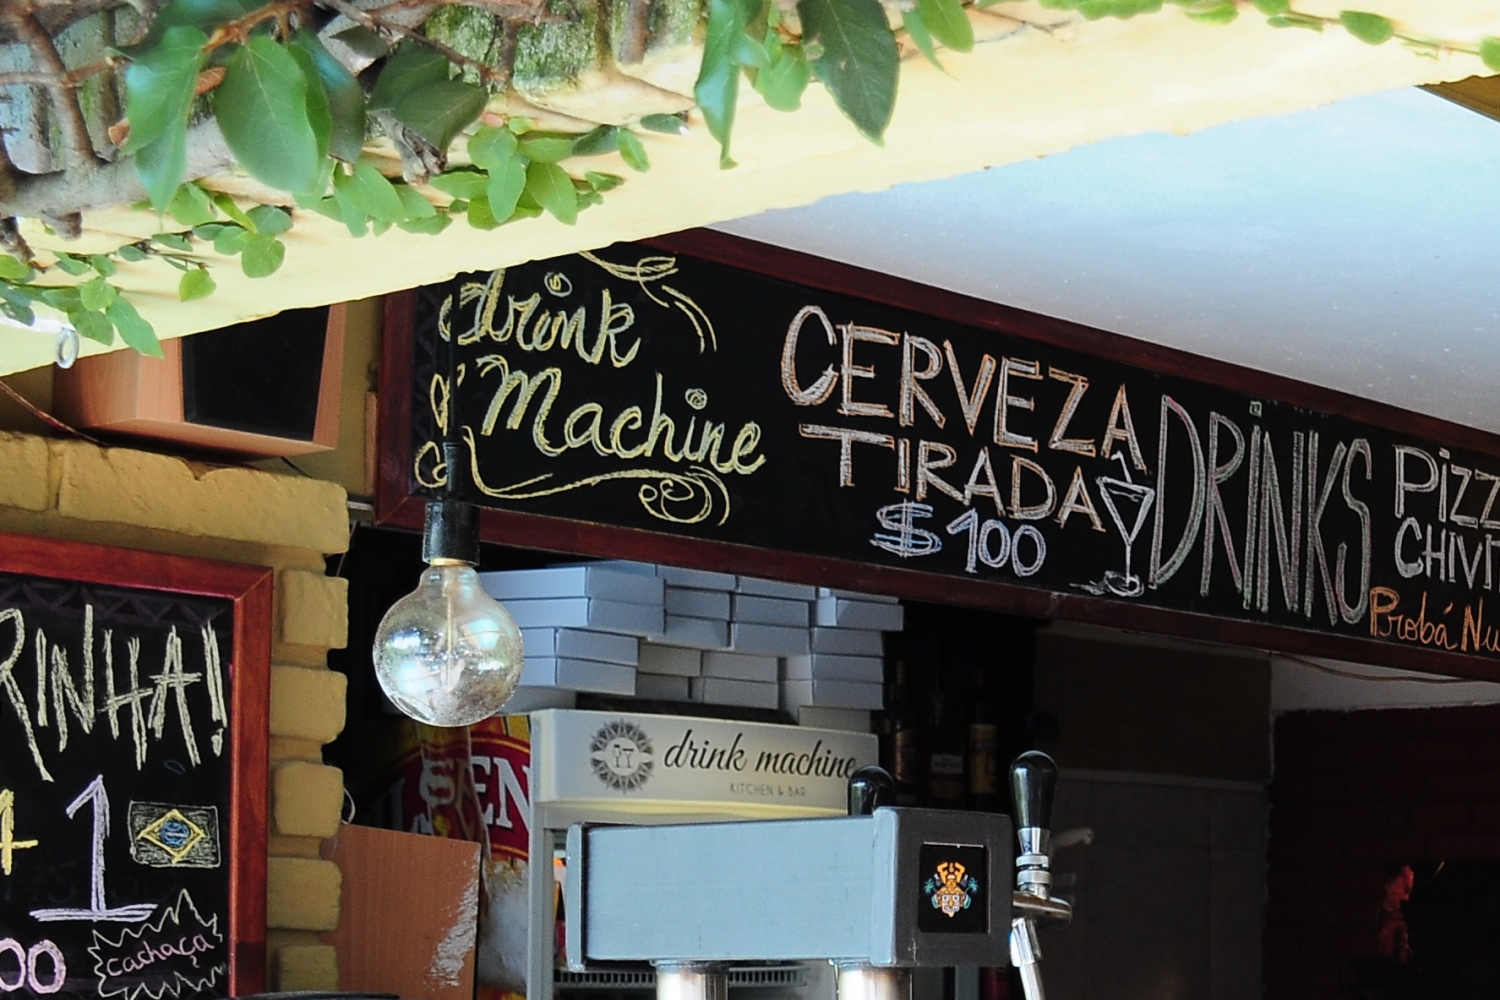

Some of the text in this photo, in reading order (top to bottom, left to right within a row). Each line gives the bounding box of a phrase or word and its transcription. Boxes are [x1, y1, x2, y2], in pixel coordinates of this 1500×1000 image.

[477, 354, 766, 475] Machine
[780, 305, 1147, 475] CERVEZA
[799, 423, 1107, 532] TIRADA
[1370, 586, 1458, 650] Probá
[664, 729, 857, 780] drink machine
